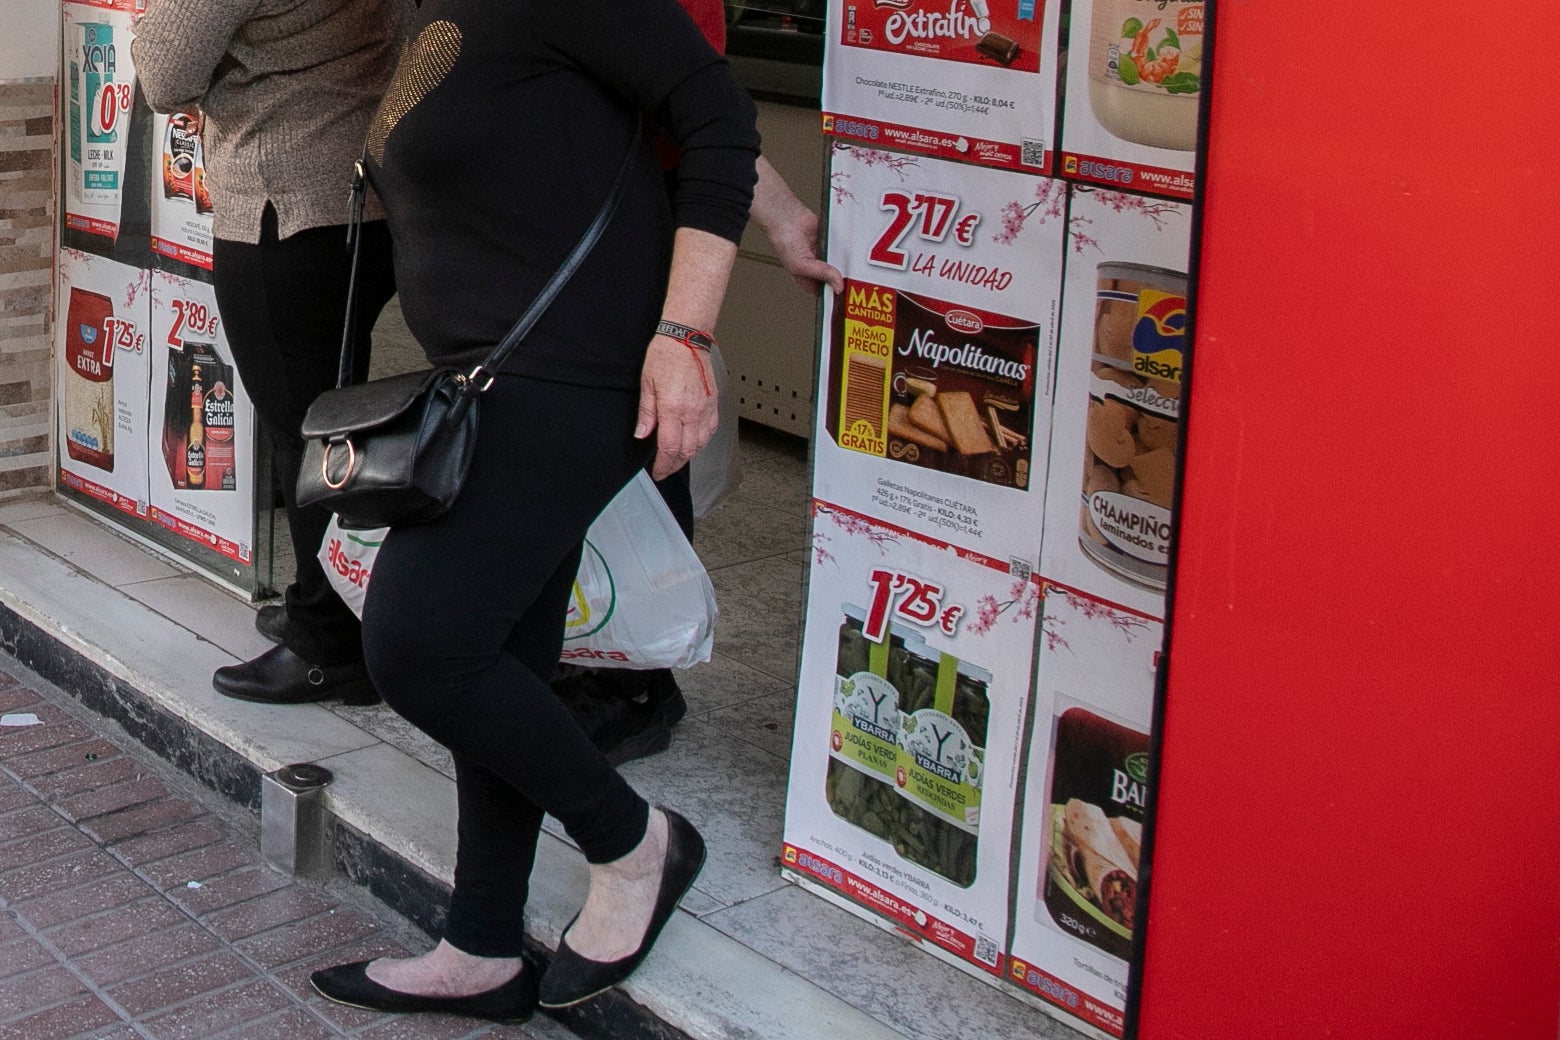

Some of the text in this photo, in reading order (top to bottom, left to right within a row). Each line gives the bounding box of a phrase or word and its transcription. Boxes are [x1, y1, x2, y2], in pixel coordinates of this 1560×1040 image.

[855, 76, 888, 89] Chocolate
[889, 82, 914, 94] NESTLE
[948, 91, 962, 100] 270
[884, 127, 952, 148] www.alsara.es
[912, 254, 1013, 291] LA UNIDAD
[849, 286, 893, 312] MÁS
[848, 306, 893, 323] CANTIDAD
[947, 314, 981, 330] Cuétara
[852, 326, 888, 343] MISMO
[848, 338, 890, 357] PRECIO
[898, 328, 1028, 380] Napolitanas
[77, 356, 101, 376] EXTRA
[205, 400, 234, 413] Estrella
[206, 413, 234, 426] Galicia
[841, 432, 885, 454] GRATIS
[877, 477, 903, 492] Galletas
[904, 487, 944, 505] Napolitanas
[1100, 516, 1154, 551] laminados
[845, 731, 871, 751] JUDÍAS
[854, 718, 897, 744] YBARRA
[917, 754, 959, 784] YBARRA
[909, 768, 966, 804] JUDÍAS VERDES
[904, 871, 930, 891] YBARRA
[847, 876, 912, 916] www.alsara.es
